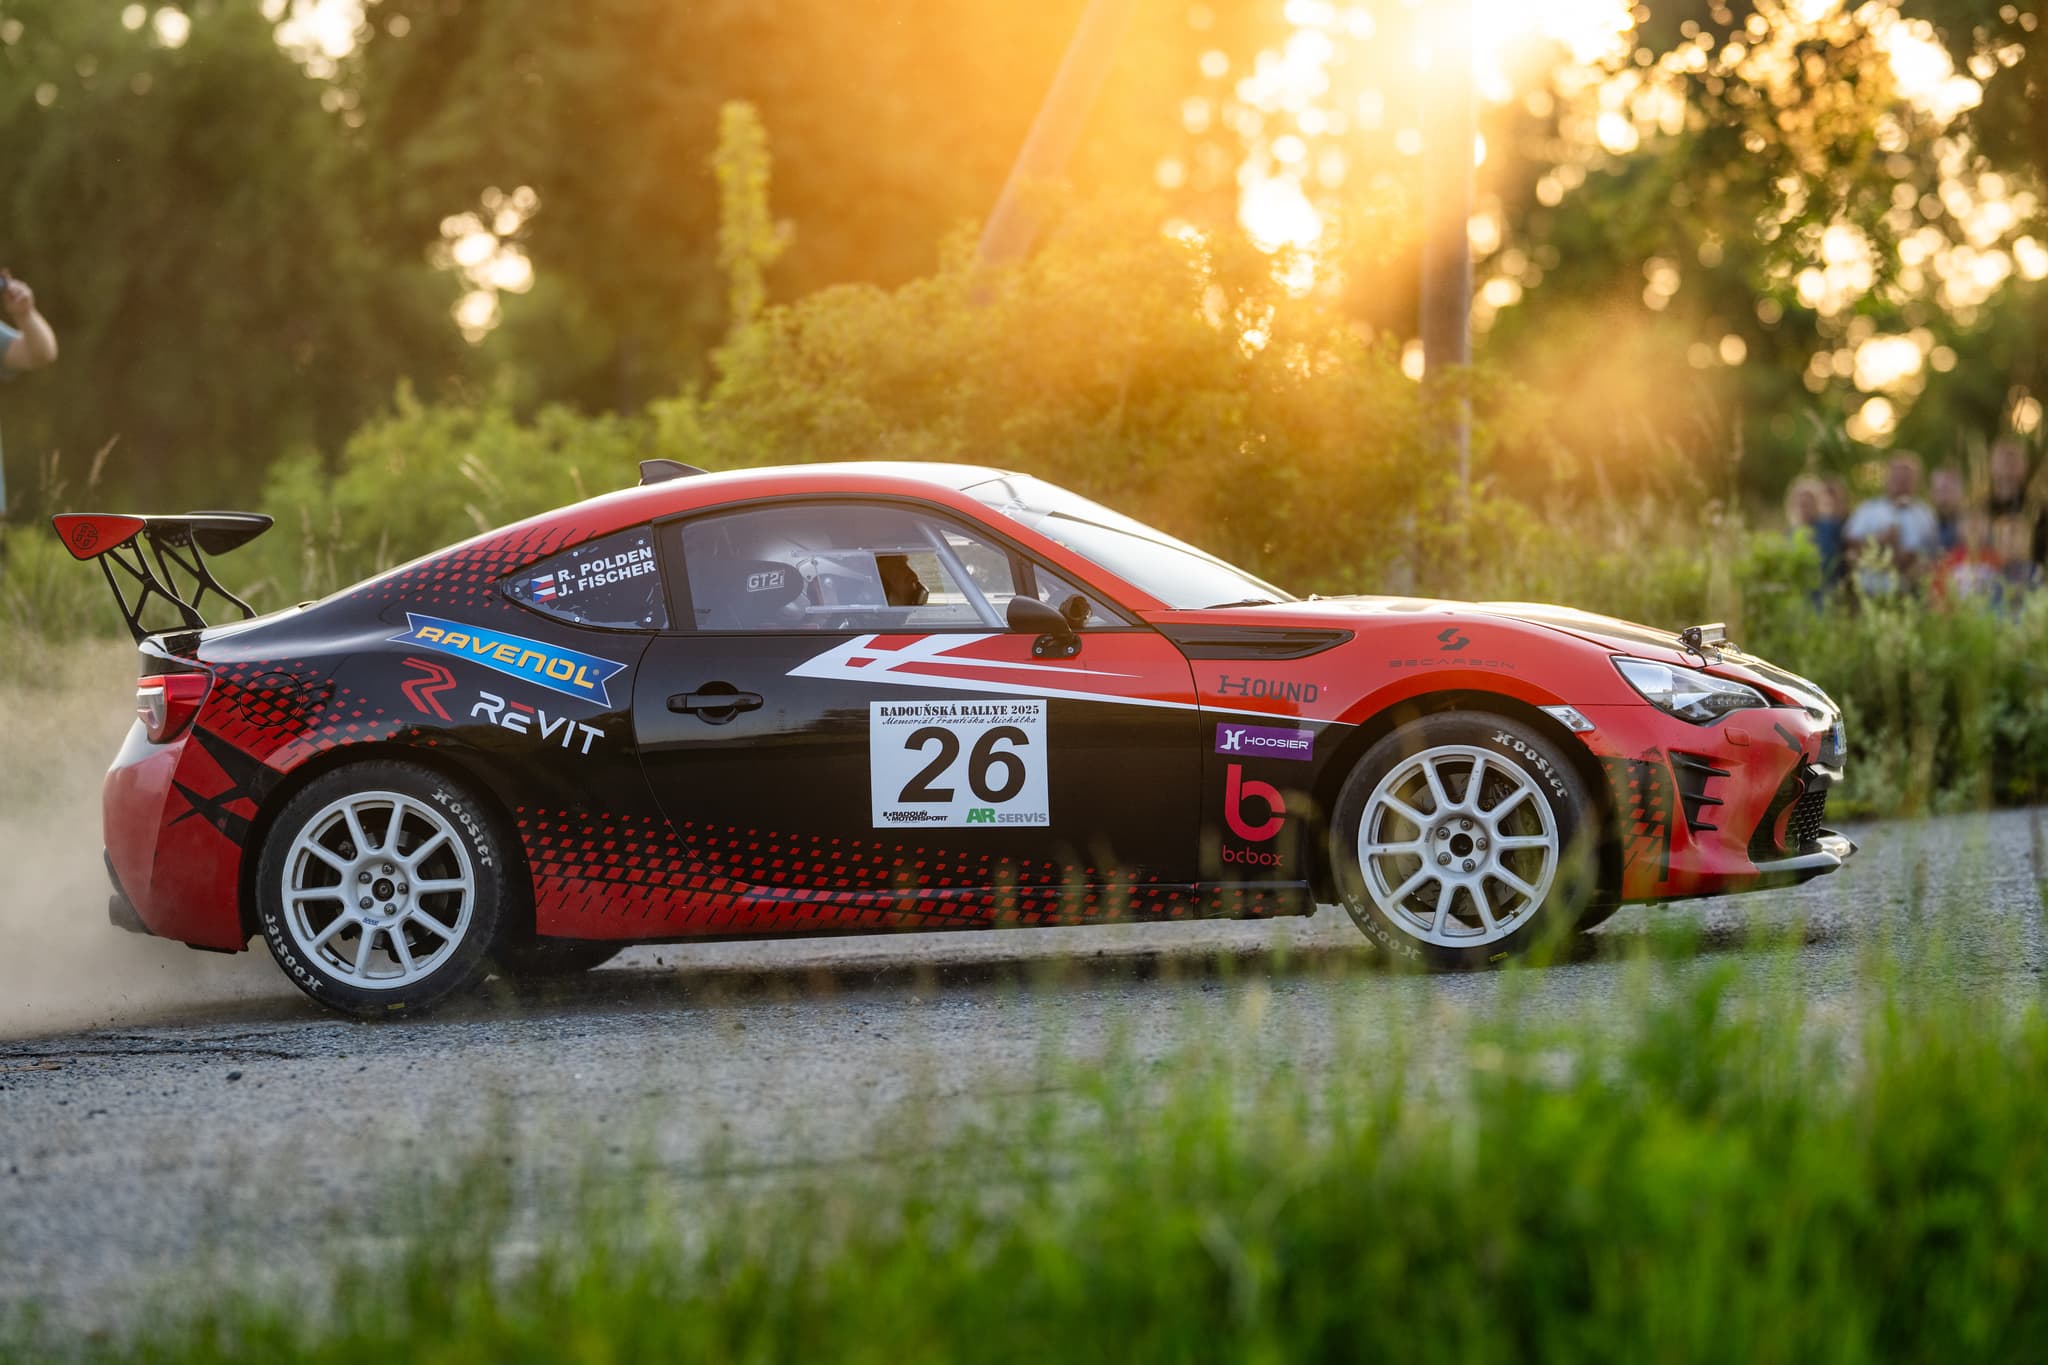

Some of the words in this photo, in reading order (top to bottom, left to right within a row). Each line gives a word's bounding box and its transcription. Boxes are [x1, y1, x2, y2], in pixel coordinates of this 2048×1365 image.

[558, 569, 575, 583] R.
[580, 546, 653, 577] POLDEN
[558, 583, 573, 597] J.
[578, 560, 656, 592] FISCHER
[415, 625, 596, 690] RAVENOL
[1217, 674, 1319, 704] HOUND
[470, 690, 605, 755] REVIT
[880, 704, 957, 717] RADOUŇSKÁ
[961, 705, 1008, 716] RALLYE
[1011, 705, 1039, 715] 2025
[1244, 736, 1309, 750] HOOSIER
[898, 725, 1030, 804] 26
[966, 807, 996, 824] AR
[1223, 844, 1284, 867] bcbox
